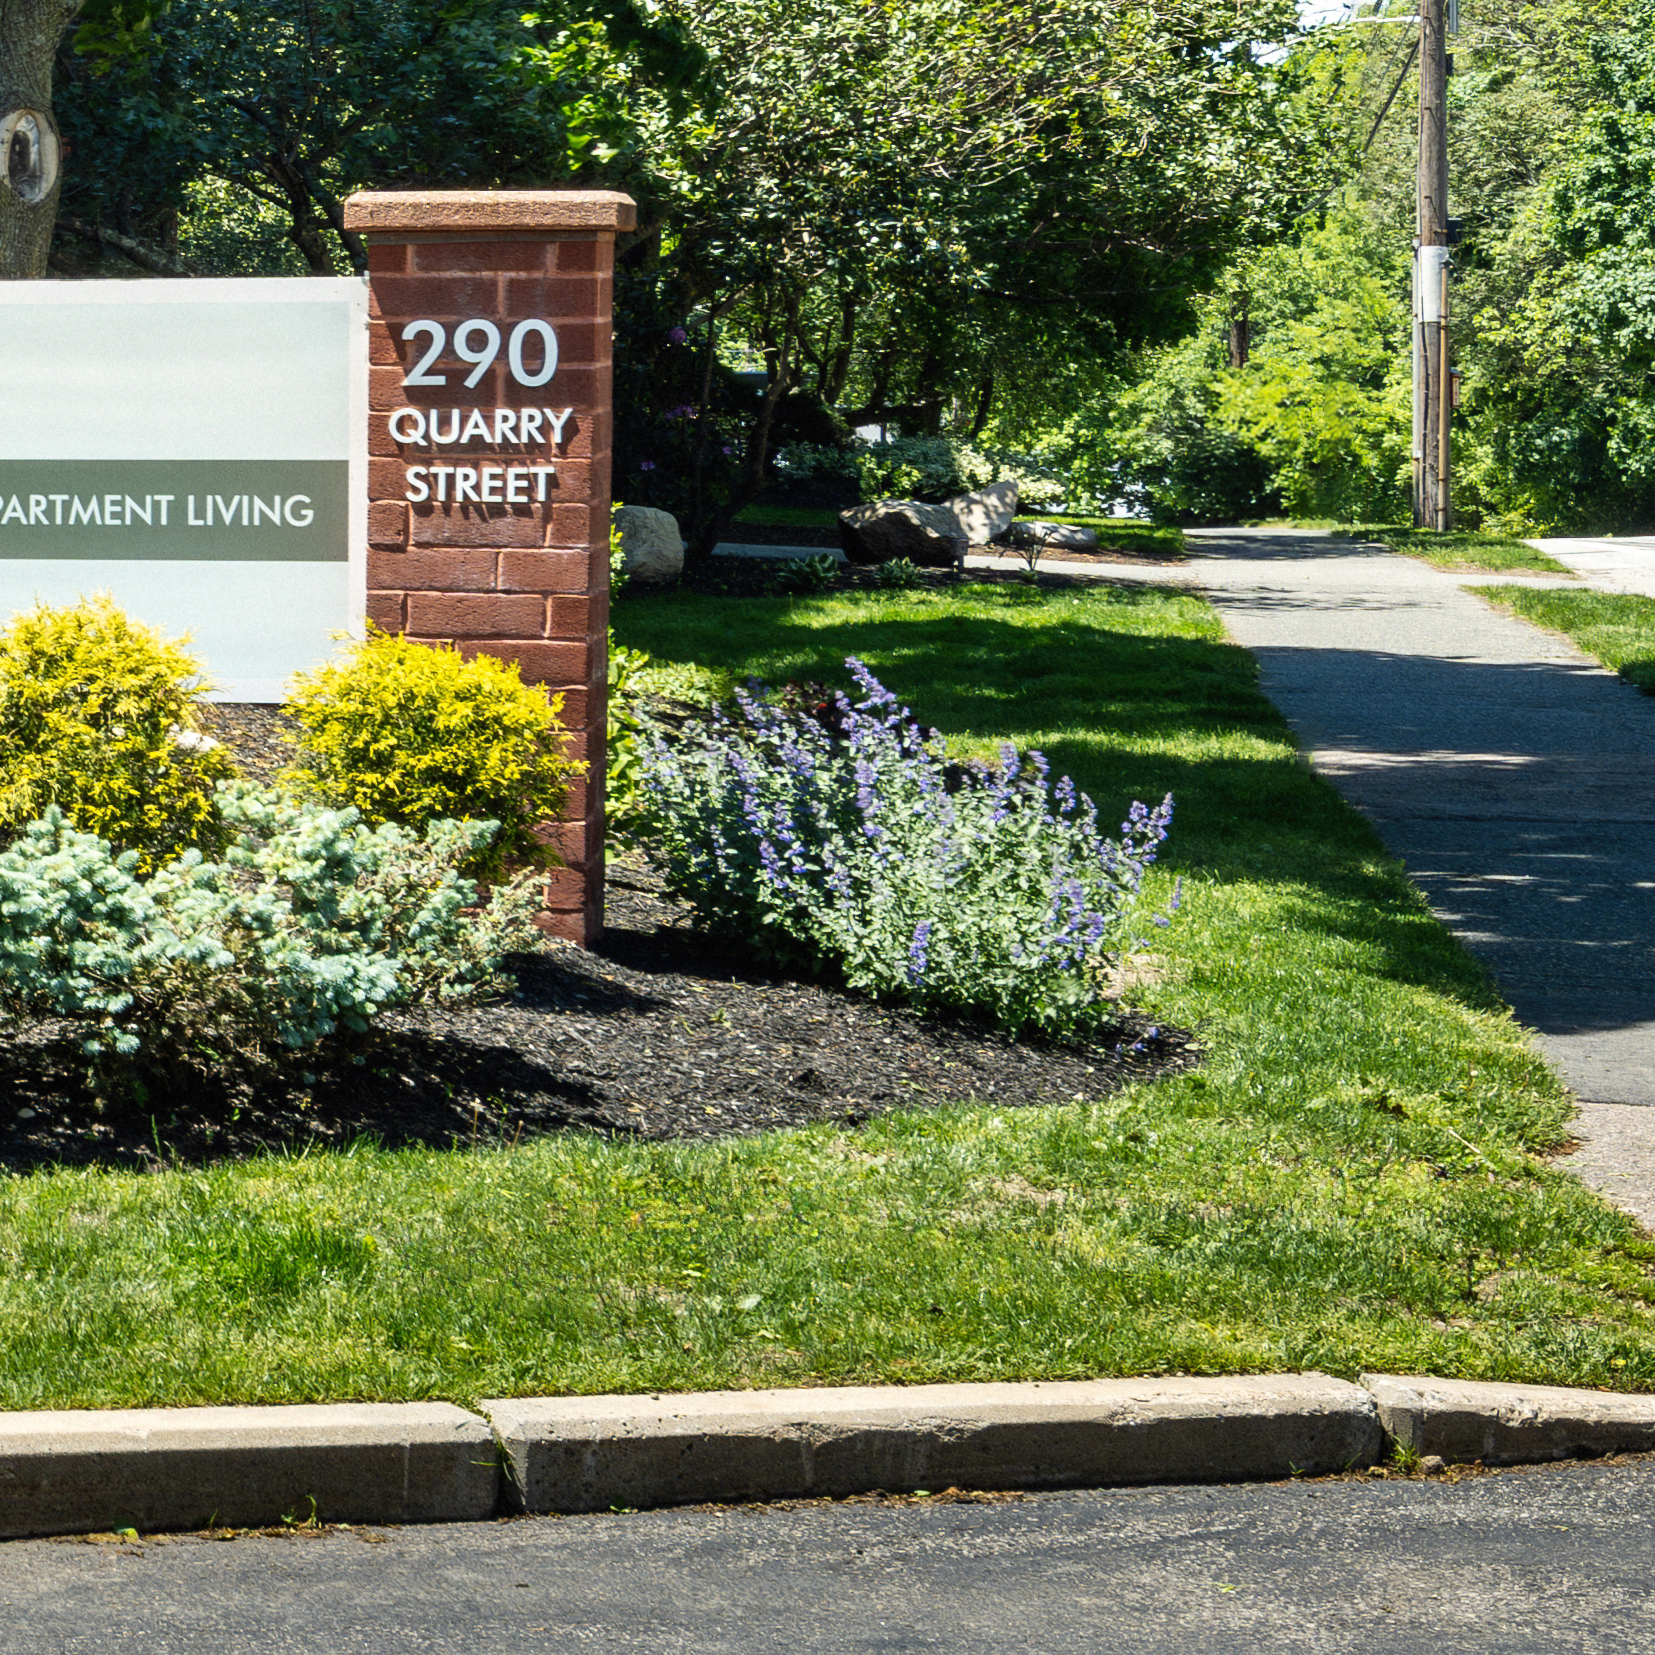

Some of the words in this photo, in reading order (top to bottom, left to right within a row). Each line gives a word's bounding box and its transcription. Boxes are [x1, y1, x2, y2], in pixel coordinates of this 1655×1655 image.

[401, 318, 559, 389] 290
[388, 407, 574, 446] QUARRY
[405, 466, 556, 503] STREET
[187, 493, 315, 528] LIVING
